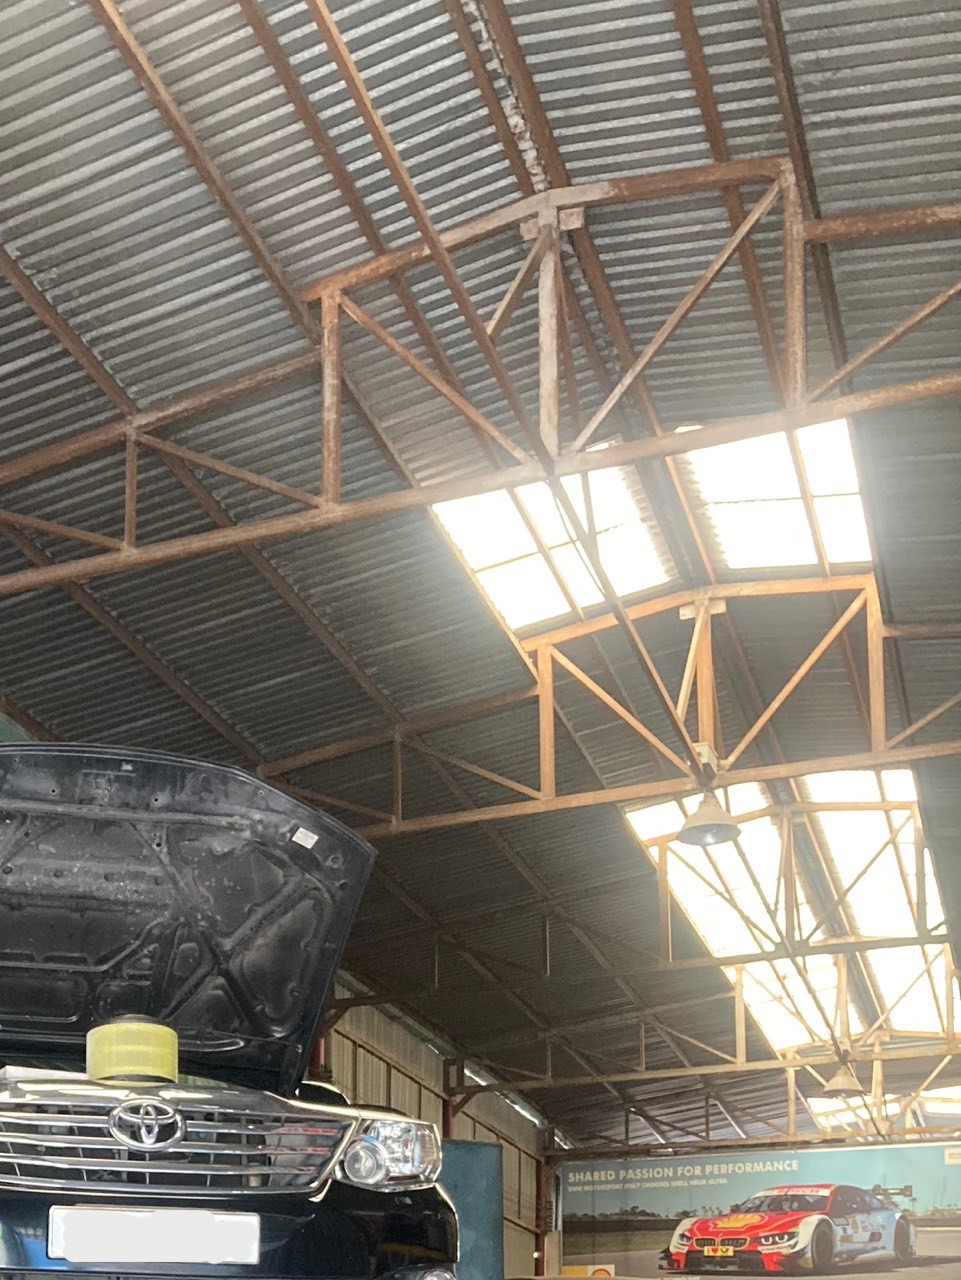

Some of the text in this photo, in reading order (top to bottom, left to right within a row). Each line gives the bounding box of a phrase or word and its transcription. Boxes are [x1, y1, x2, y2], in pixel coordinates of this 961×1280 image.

[568, 1160, 799, 1183] SHARED PASSION FOR PERFORMANCE
